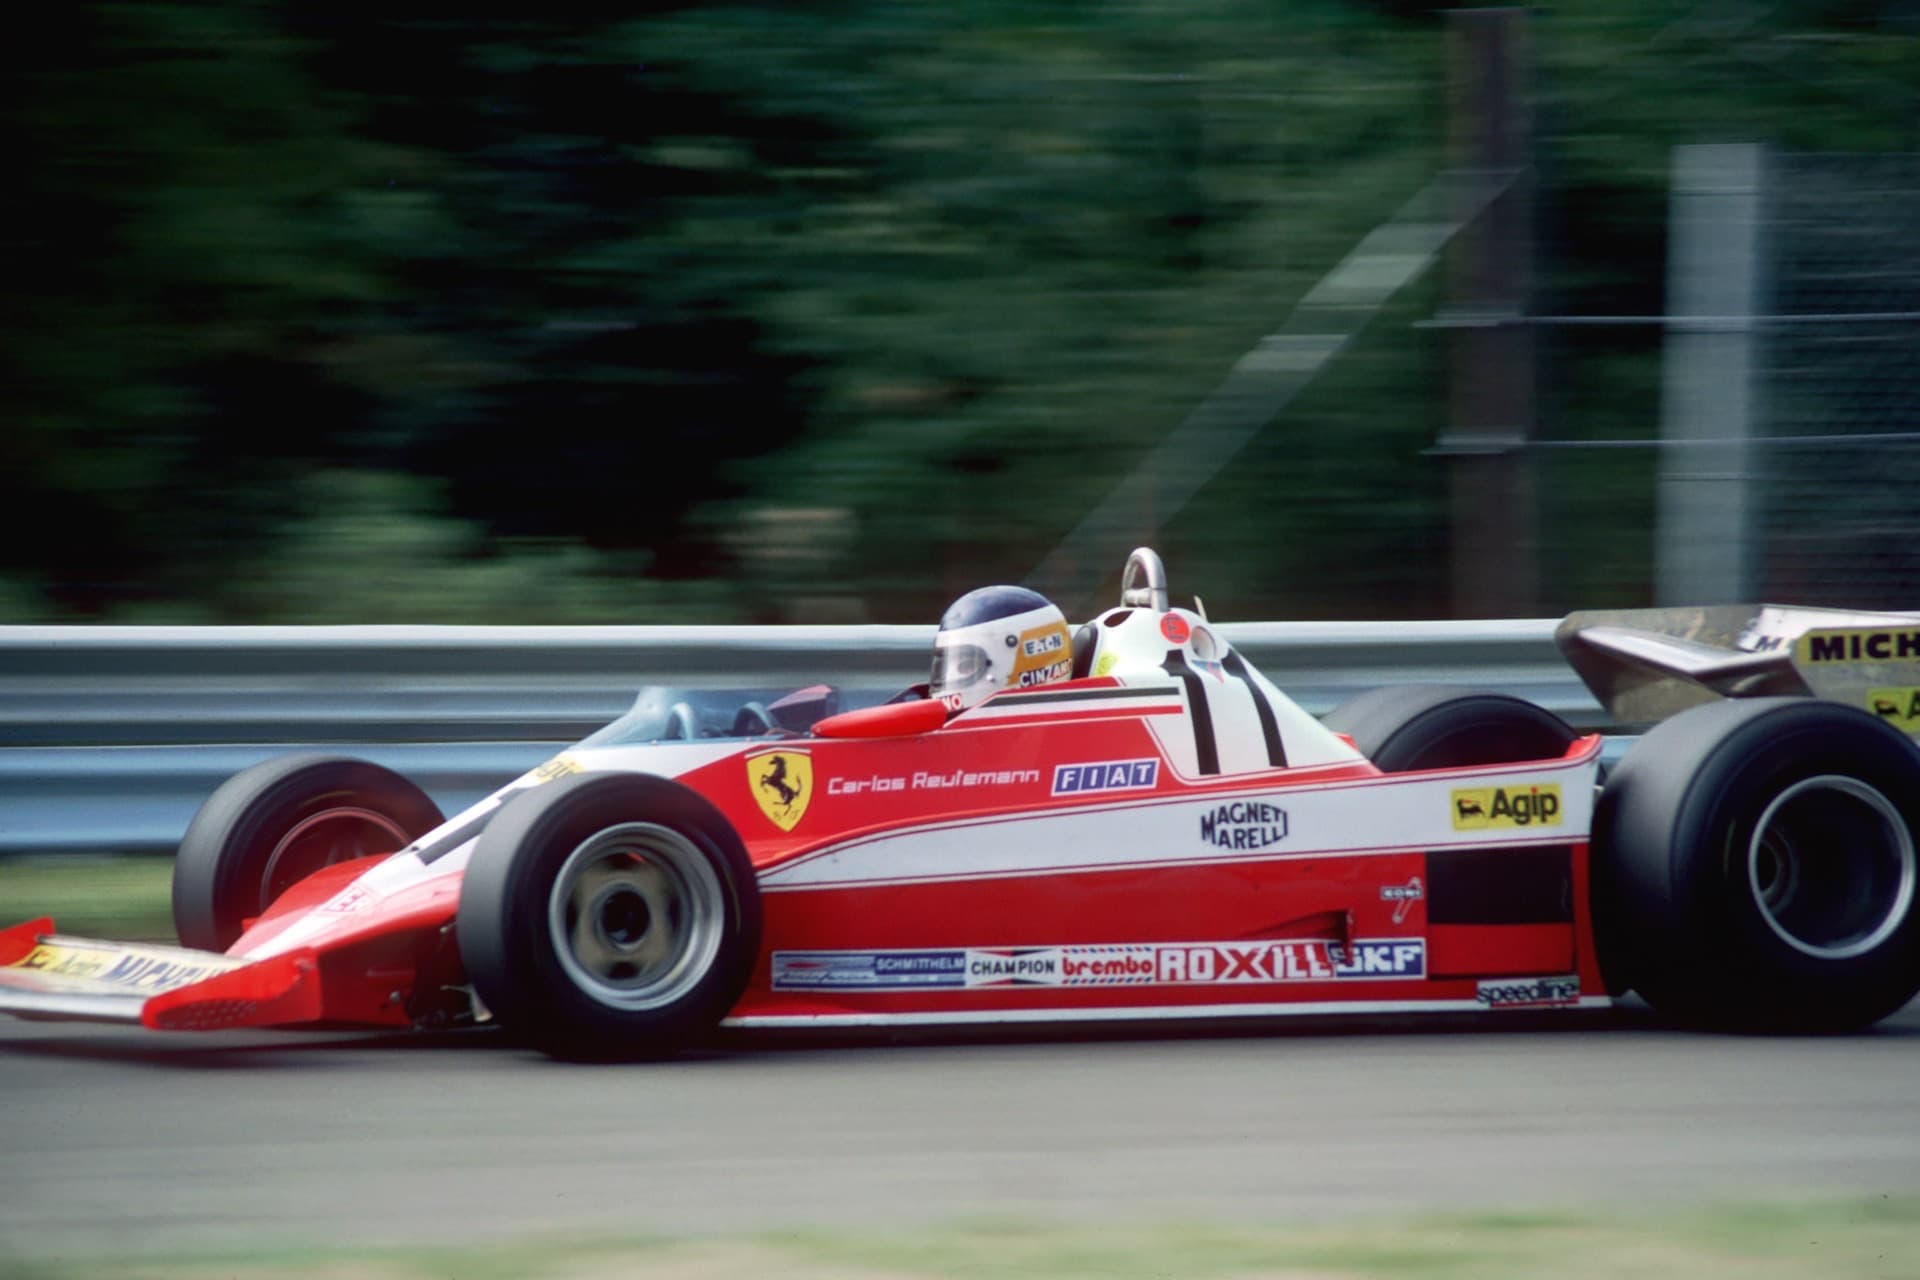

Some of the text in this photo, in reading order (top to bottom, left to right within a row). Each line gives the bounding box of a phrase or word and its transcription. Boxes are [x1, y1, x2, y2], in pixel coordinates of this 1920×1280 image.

[1811, 632, 1920, 660] MICH
[1020, 659, 1073, 687] CINZAN
[827, 769, 1040, 795] Carlos Reutemann
[1057, 763, 1153, 791] FIAT
[1490, 787, 1559, 825] Agip
[876, 956, 965, 971] SCHMITTHELM
[970, 959, 1055, 976] CHAMPION
[1062, 953, 1153, 976] brembo
[1159, 943, 1332, 981] ROXILL
